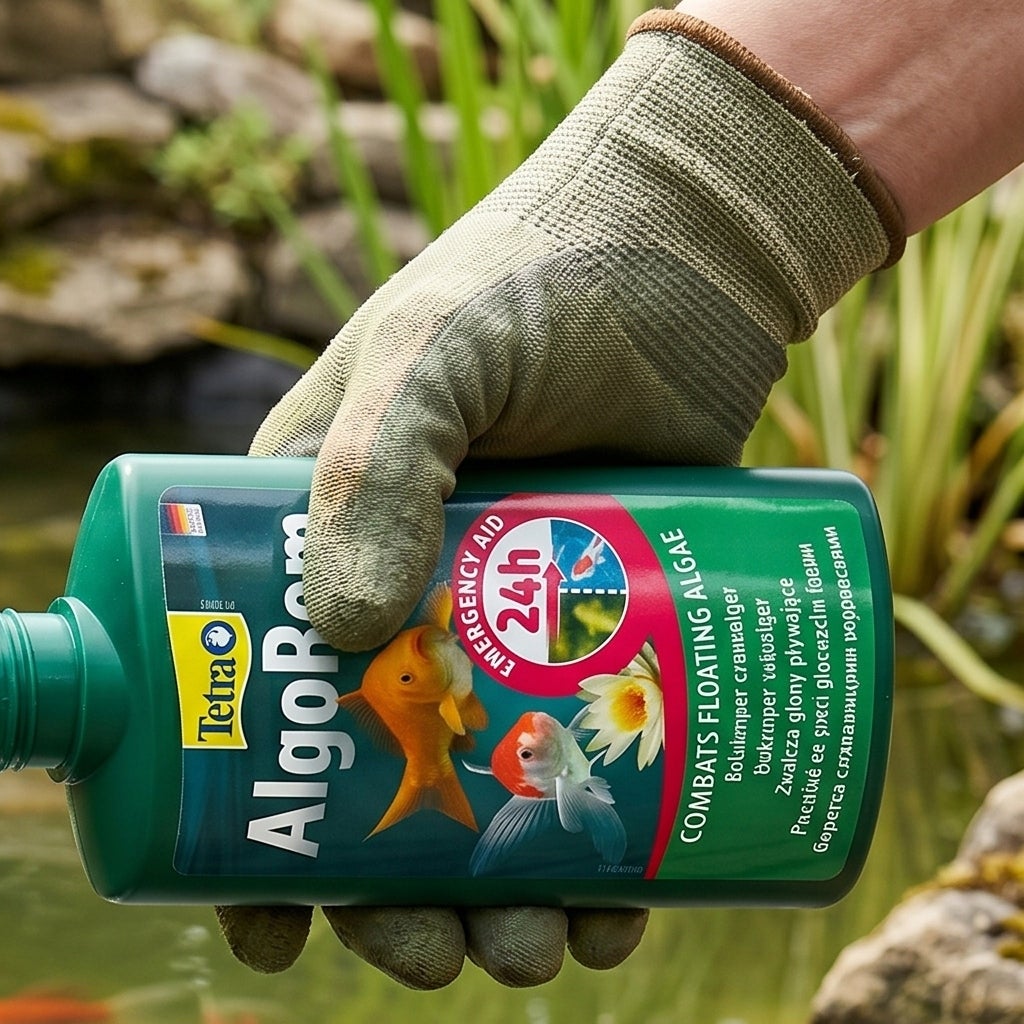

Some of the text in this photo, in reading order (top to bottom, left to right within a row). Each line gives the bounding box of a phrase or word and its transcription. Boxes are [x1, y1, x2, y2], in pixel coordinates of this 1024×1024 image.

[458, 515, 516, 678] EMERGENCY AID
[496, 549, 541, 633] 24h
[198, 657, 237, 743] Tetra
[660, 528, 720, 843] COMBATS FLOATING ALGAE
[774, 577, 808, 796] Zwalcza glony pływające
